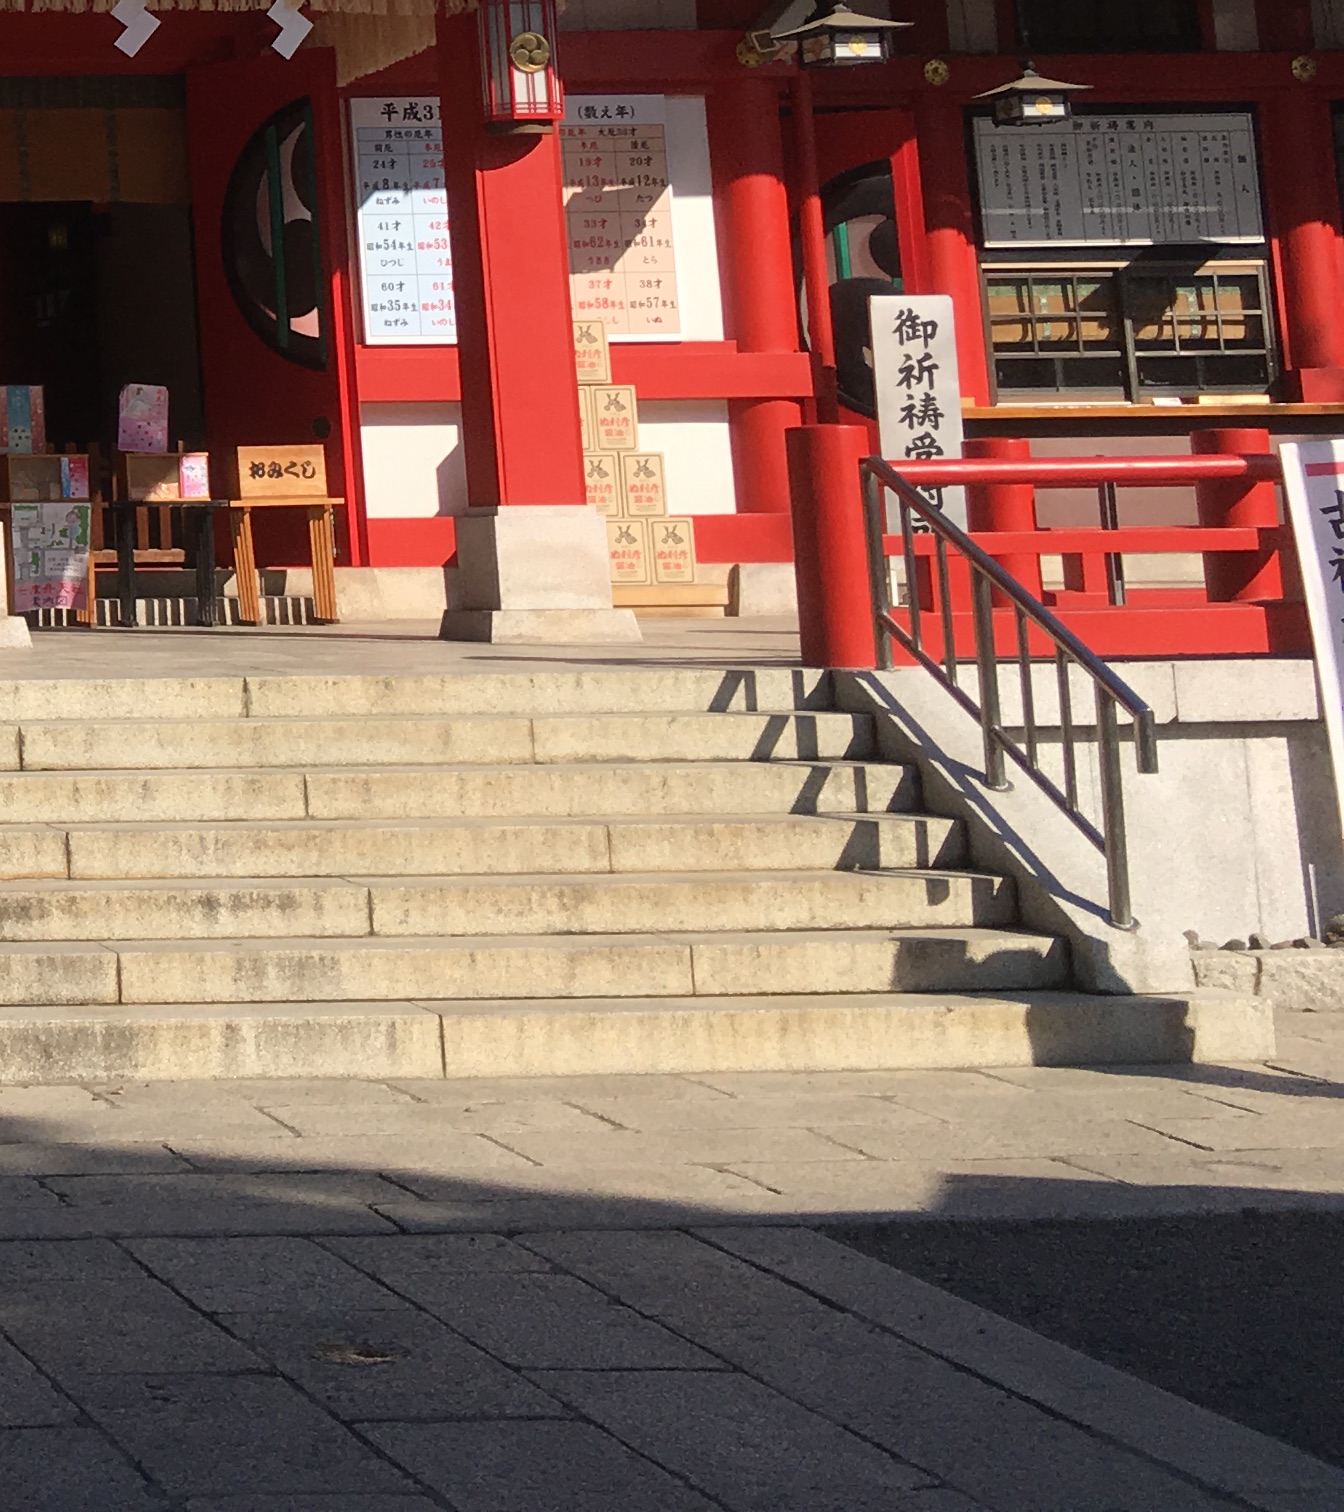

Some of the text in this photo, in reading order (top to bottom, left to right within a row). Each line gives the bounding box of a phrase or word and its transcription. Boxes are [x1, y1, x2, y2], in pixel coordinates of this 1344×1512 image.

[381, 102, 442, 122] 平成3
[578, 105, 634, 119] (数え年)
[373, 158, 397, 169] 24才
[629, 156, 653, 166] 20才
[414, 178, 445, 190] 平成7
[376, 197, 400, 205] ねずみ
[378, 220, 401, 231] 41才
[381, 258, 404, 267] ひつじ
[643, 256, 658, 264] とら
[381, 281, 405, 292] 60才
[589, 278, 612, 290] 37才
[639, 278, 663, 289] 38才
[579, 297, 625, 310] 昭和58年生
[630, 297, 676, 309] 昭和57年生
[384, 319, 408, 327] ねずみ
[891, 307, 945, 534] 御祈祷受
[249, 460, 318, 479] おみくじ
